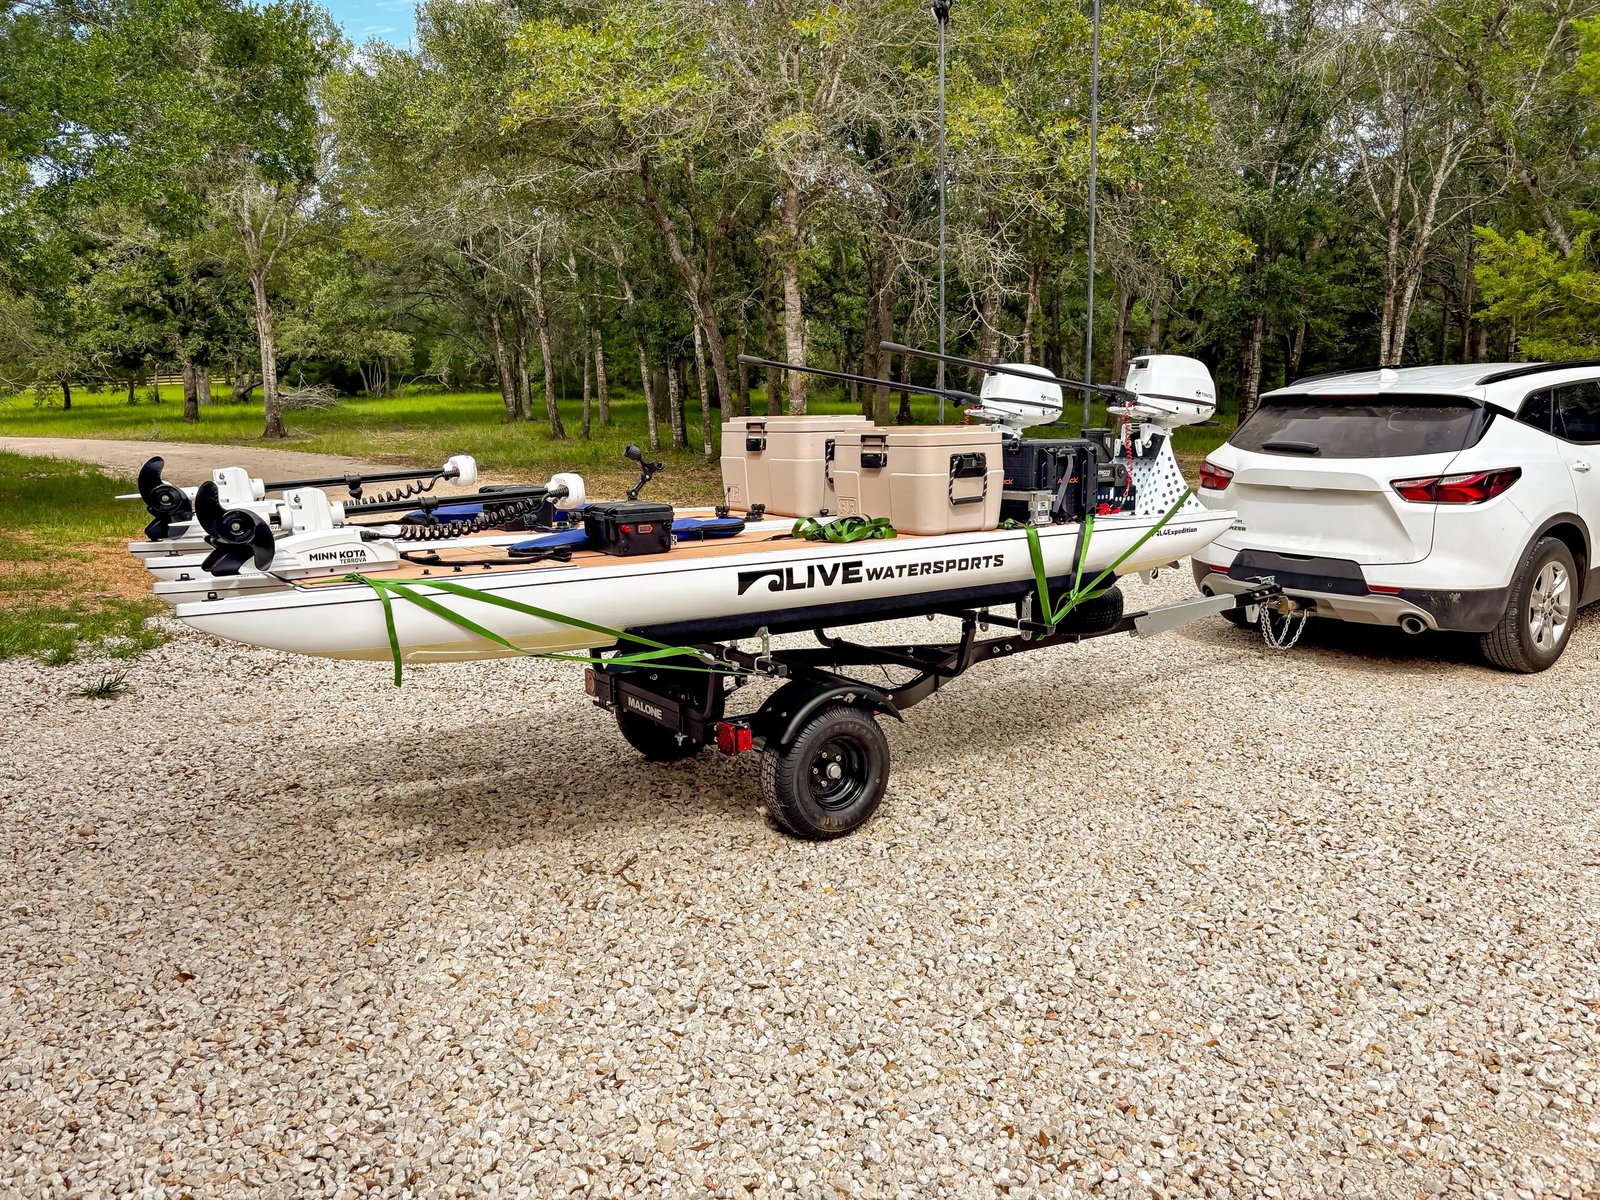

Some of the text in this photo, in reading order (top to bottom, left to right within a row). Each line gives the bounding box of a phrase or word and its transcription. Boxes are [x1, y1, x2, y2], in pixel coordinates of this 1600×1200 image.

[309, 549, 366, 561] MINN KOTA
[866, 554, 1004, 581] WATERSPORTS
[628, 696, 663, 720] MALONE
